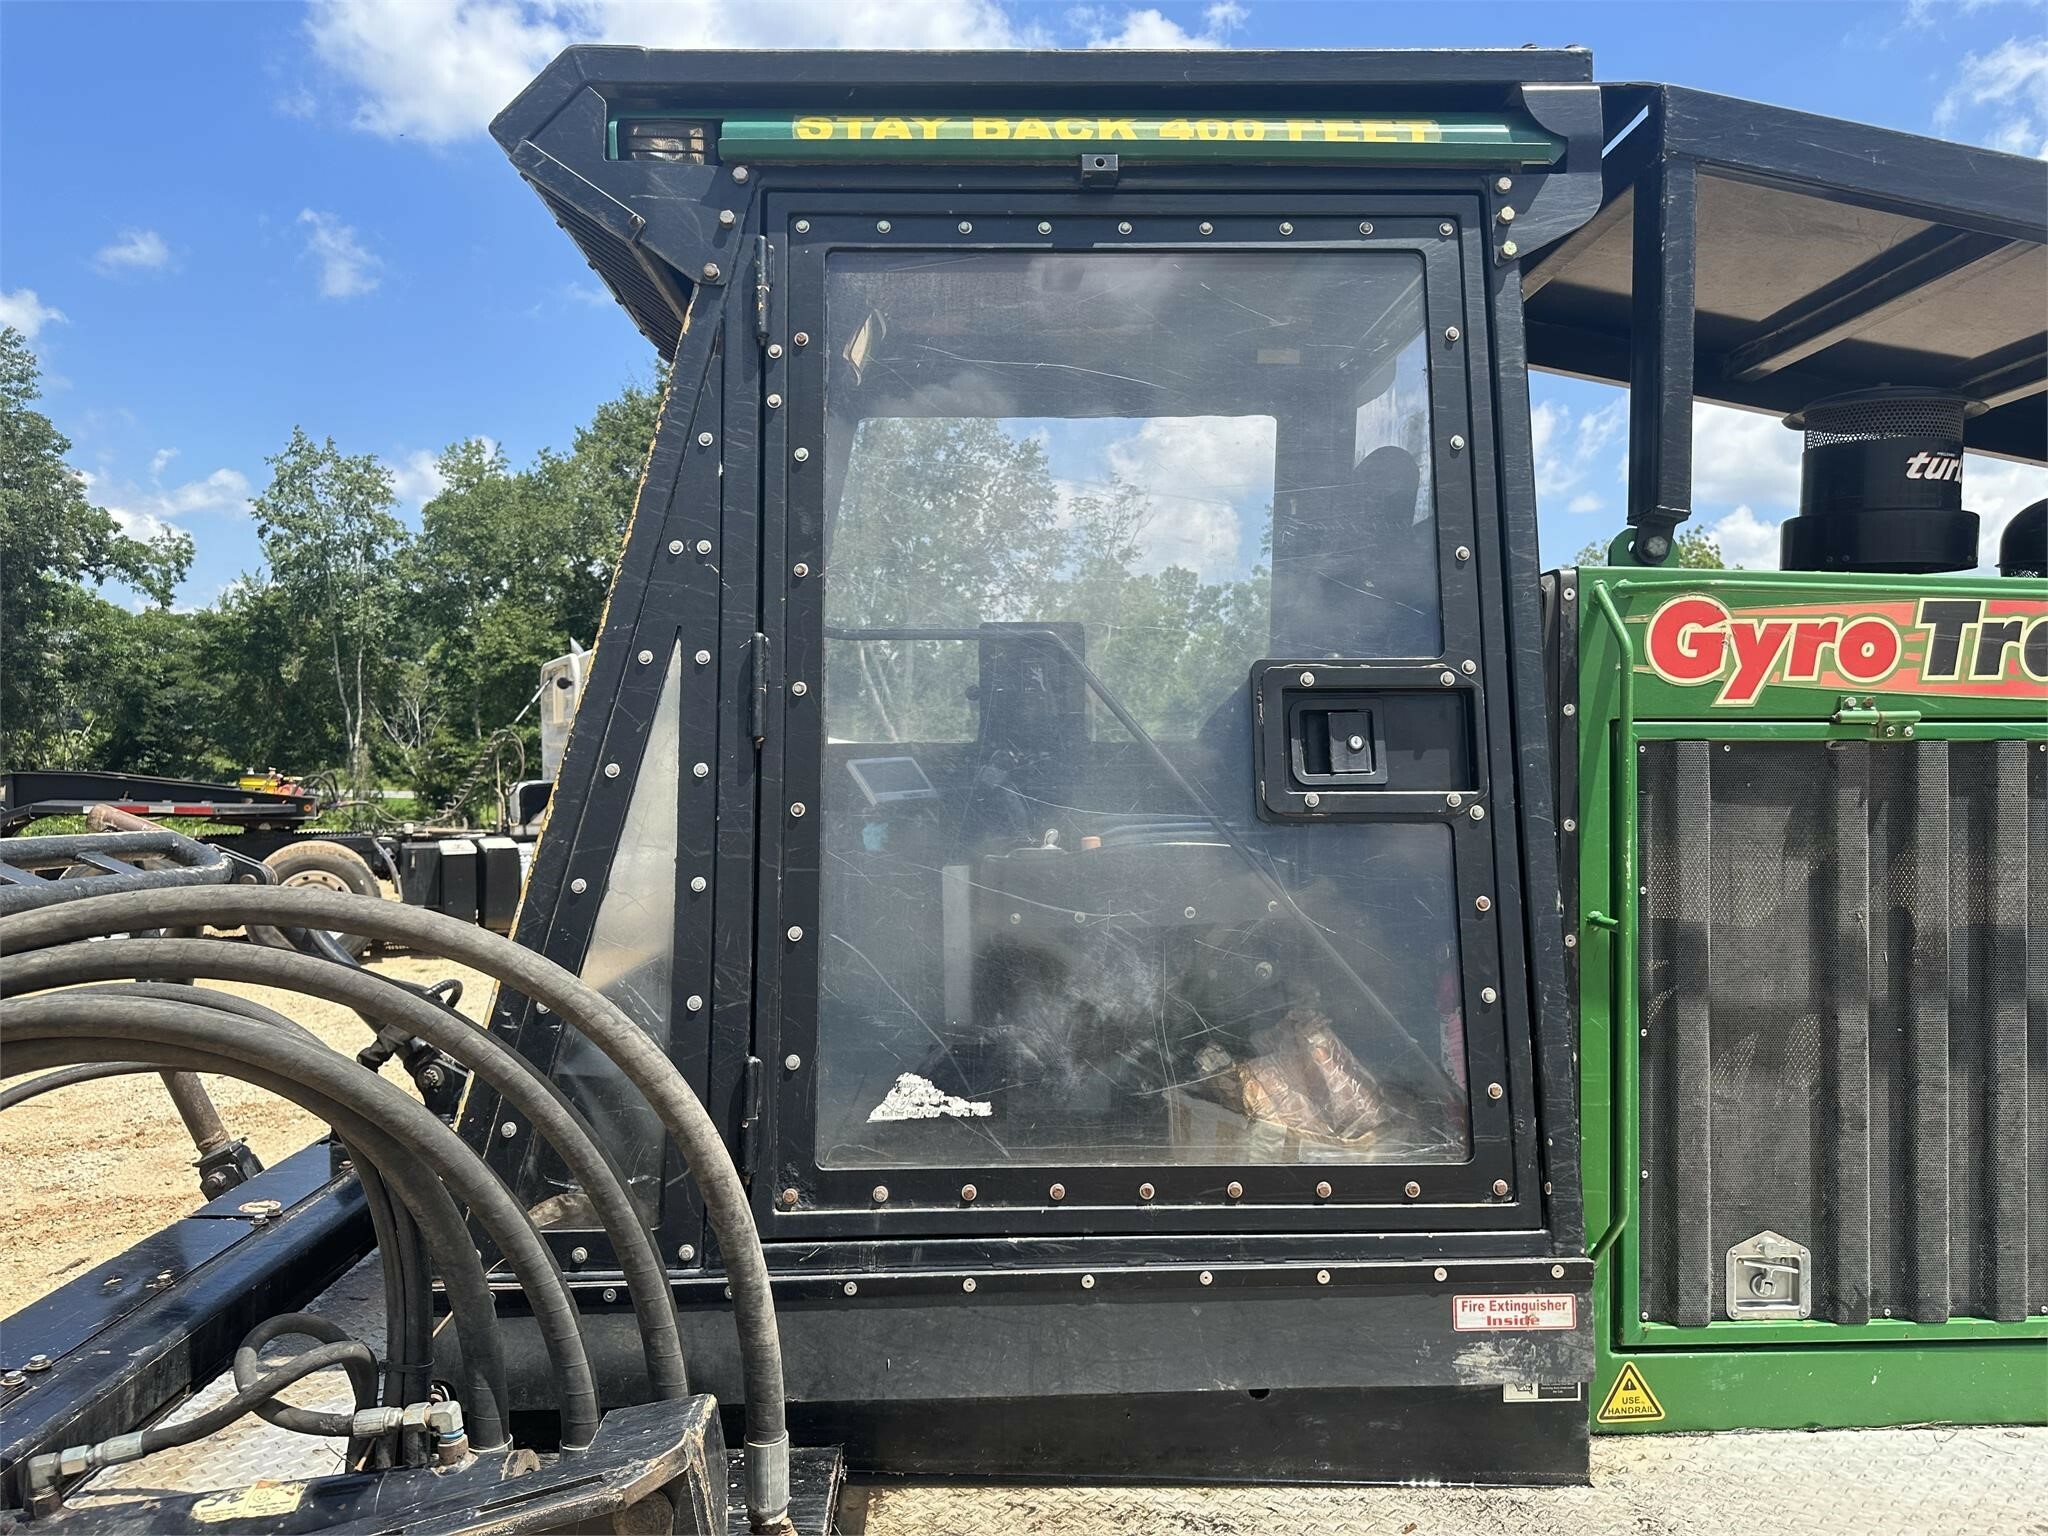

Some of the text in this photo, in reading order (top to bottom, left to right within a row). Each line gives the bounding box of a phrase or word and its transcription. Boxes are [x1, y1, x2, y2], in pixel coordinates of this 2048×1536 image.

[796, 117, 1434, 142] STAY BACK 400 FEET
[1647, 596, 1901, 706] Gyro
[1461, 1299, 1567, 1314] Fire Extinguisher
[1486, 1315, 1540, 1326] Inside
[1622, 1396, 1641, 1405] USE
[1607, 1406, 1655, 1415] HANDRAIL
